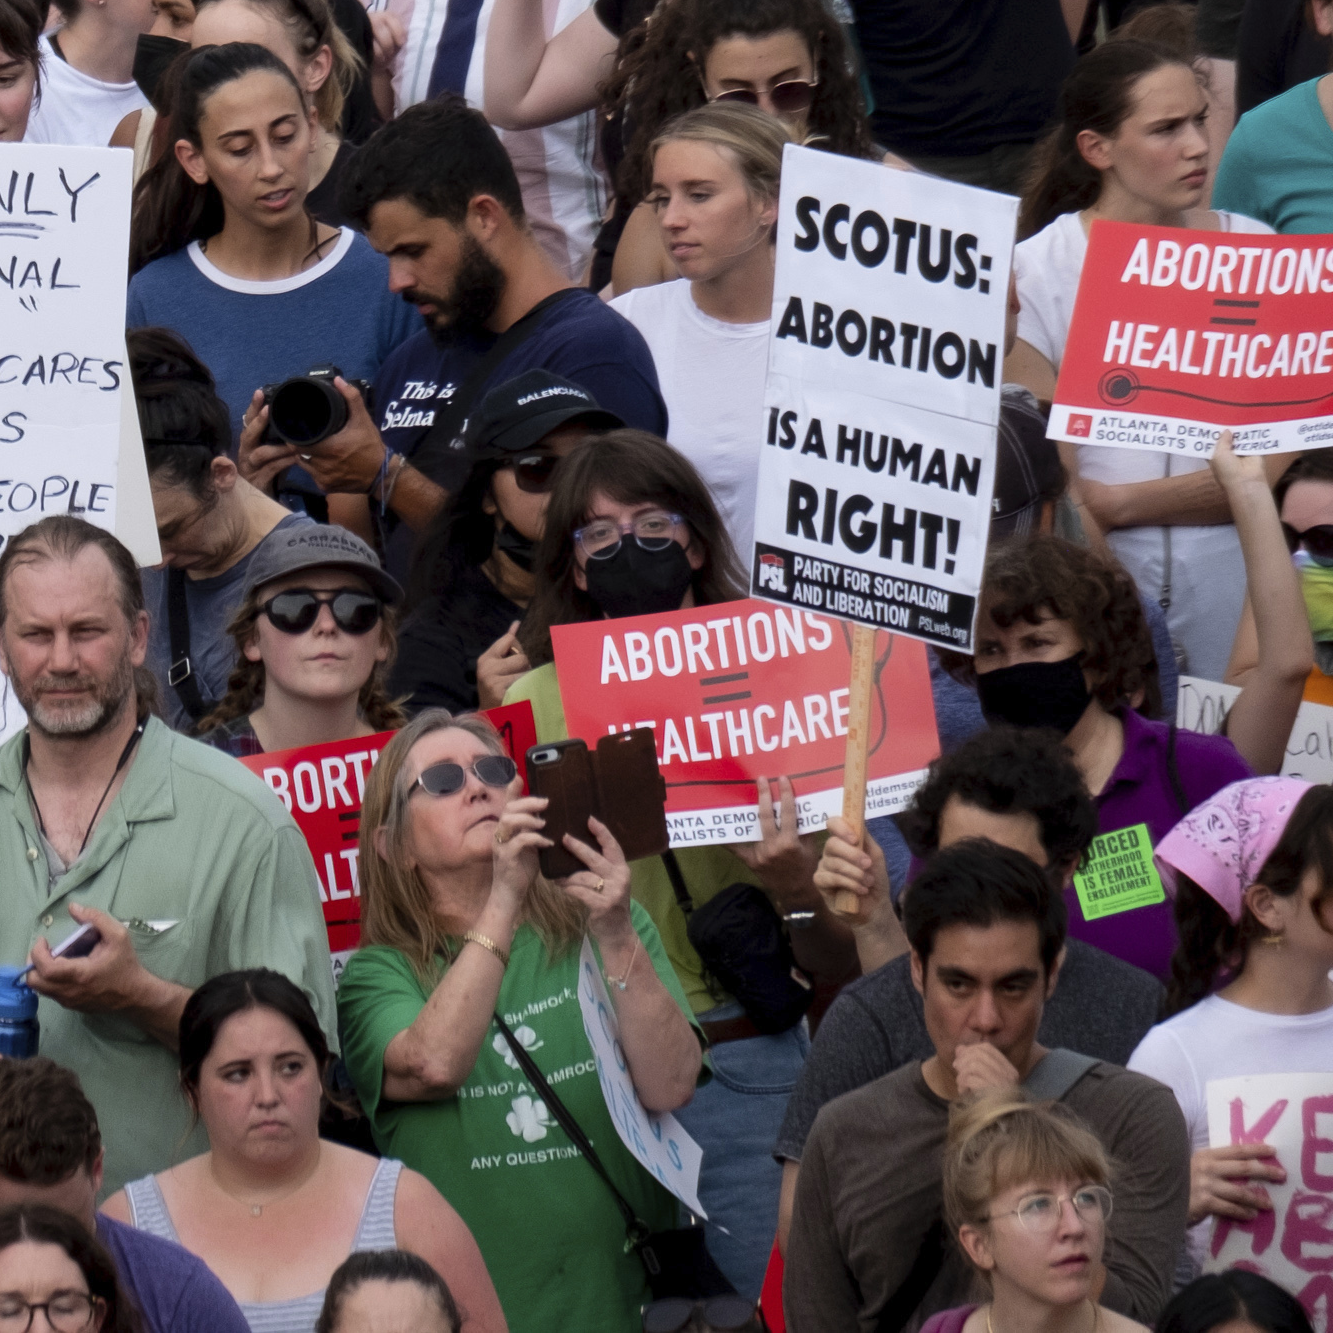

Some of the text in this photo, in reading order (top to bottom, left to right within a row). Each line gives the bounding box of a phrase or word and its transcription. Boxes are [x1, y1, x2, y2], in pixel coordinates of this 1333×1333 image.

[794, 195, 993, 295] SCOTUS:
[775, 296, 997, 389] ABORTION
[1103, 320, 1333, 379] HEALTHCARE
[400, 381, 456, 401] This is
[382, 402, 436, 432] Selma
[1096, 428, 1186, 450] SOCIALISTS
[1194, 440, 1214, 453] OF
[1098, 416, 1272, 442] ATLANTA DEMORATIC
[767, 407, 983, 497] IS A HUMAN
[785, 477, 962, 575] RIGHT!
[758, 563, 787, 594] PSL
[793, 555, 950, 614] PARTY FOR SOCIALISM
[792, 581, 823, 607] AND
[825, 589, 911, 629] LIBERATION
[600, 608, 833, 685] ABORTIONS
[1099, 861, 1149, 886] FEMALE
[470, 1154, 503, 1171] ANY
